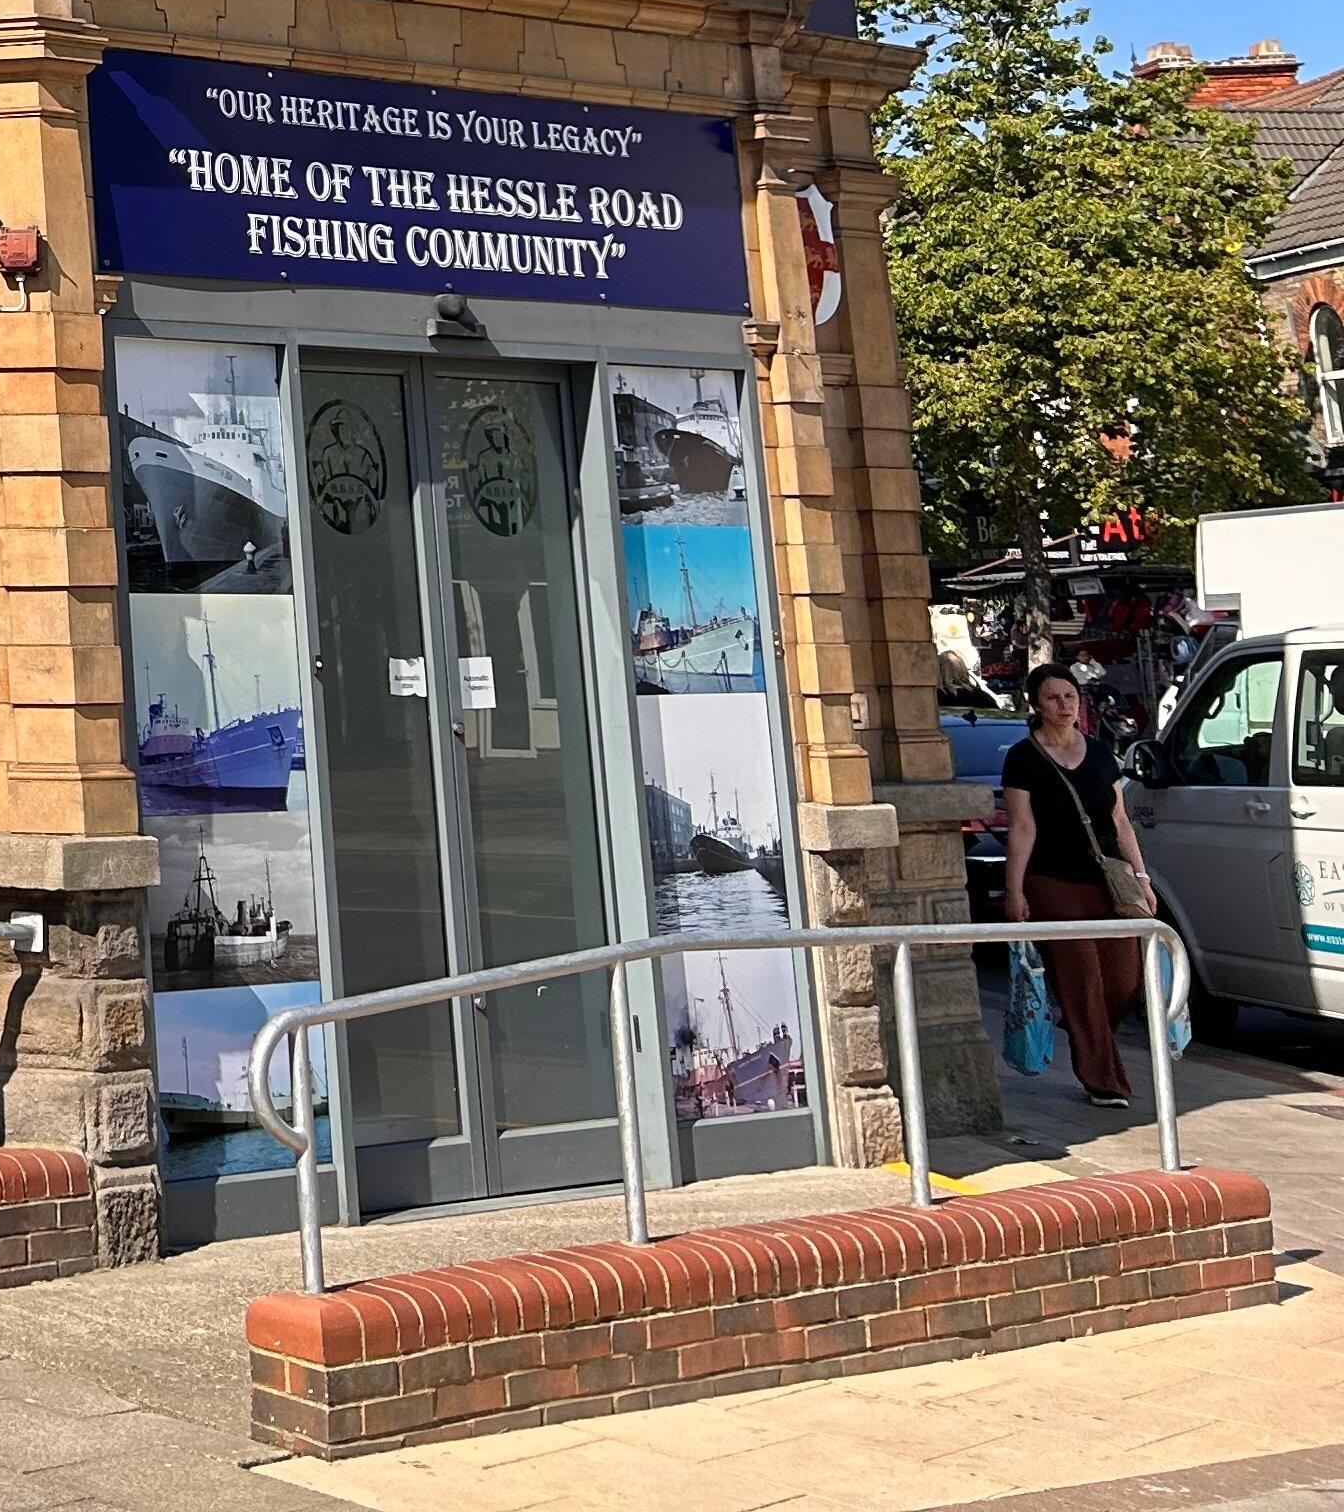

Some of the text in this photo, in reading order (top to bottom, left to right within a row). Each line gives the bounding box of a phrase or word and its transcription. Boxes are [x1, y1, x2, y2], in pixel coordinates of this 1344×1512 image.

[280, 96, 422, 138] HERITAGE
[427, 110, 453, 141] IS
[457, 110, 528, 149] YOUR
[305, 162, 354, 203] OF
[361, 166, 440, 212] THE
[446, 173, 583, 223] HESSLE
[588, 187, 685, 232] ROAD
[246, 213, 398, 265] FISHING
[1318, 860, 1344, 880] EA
